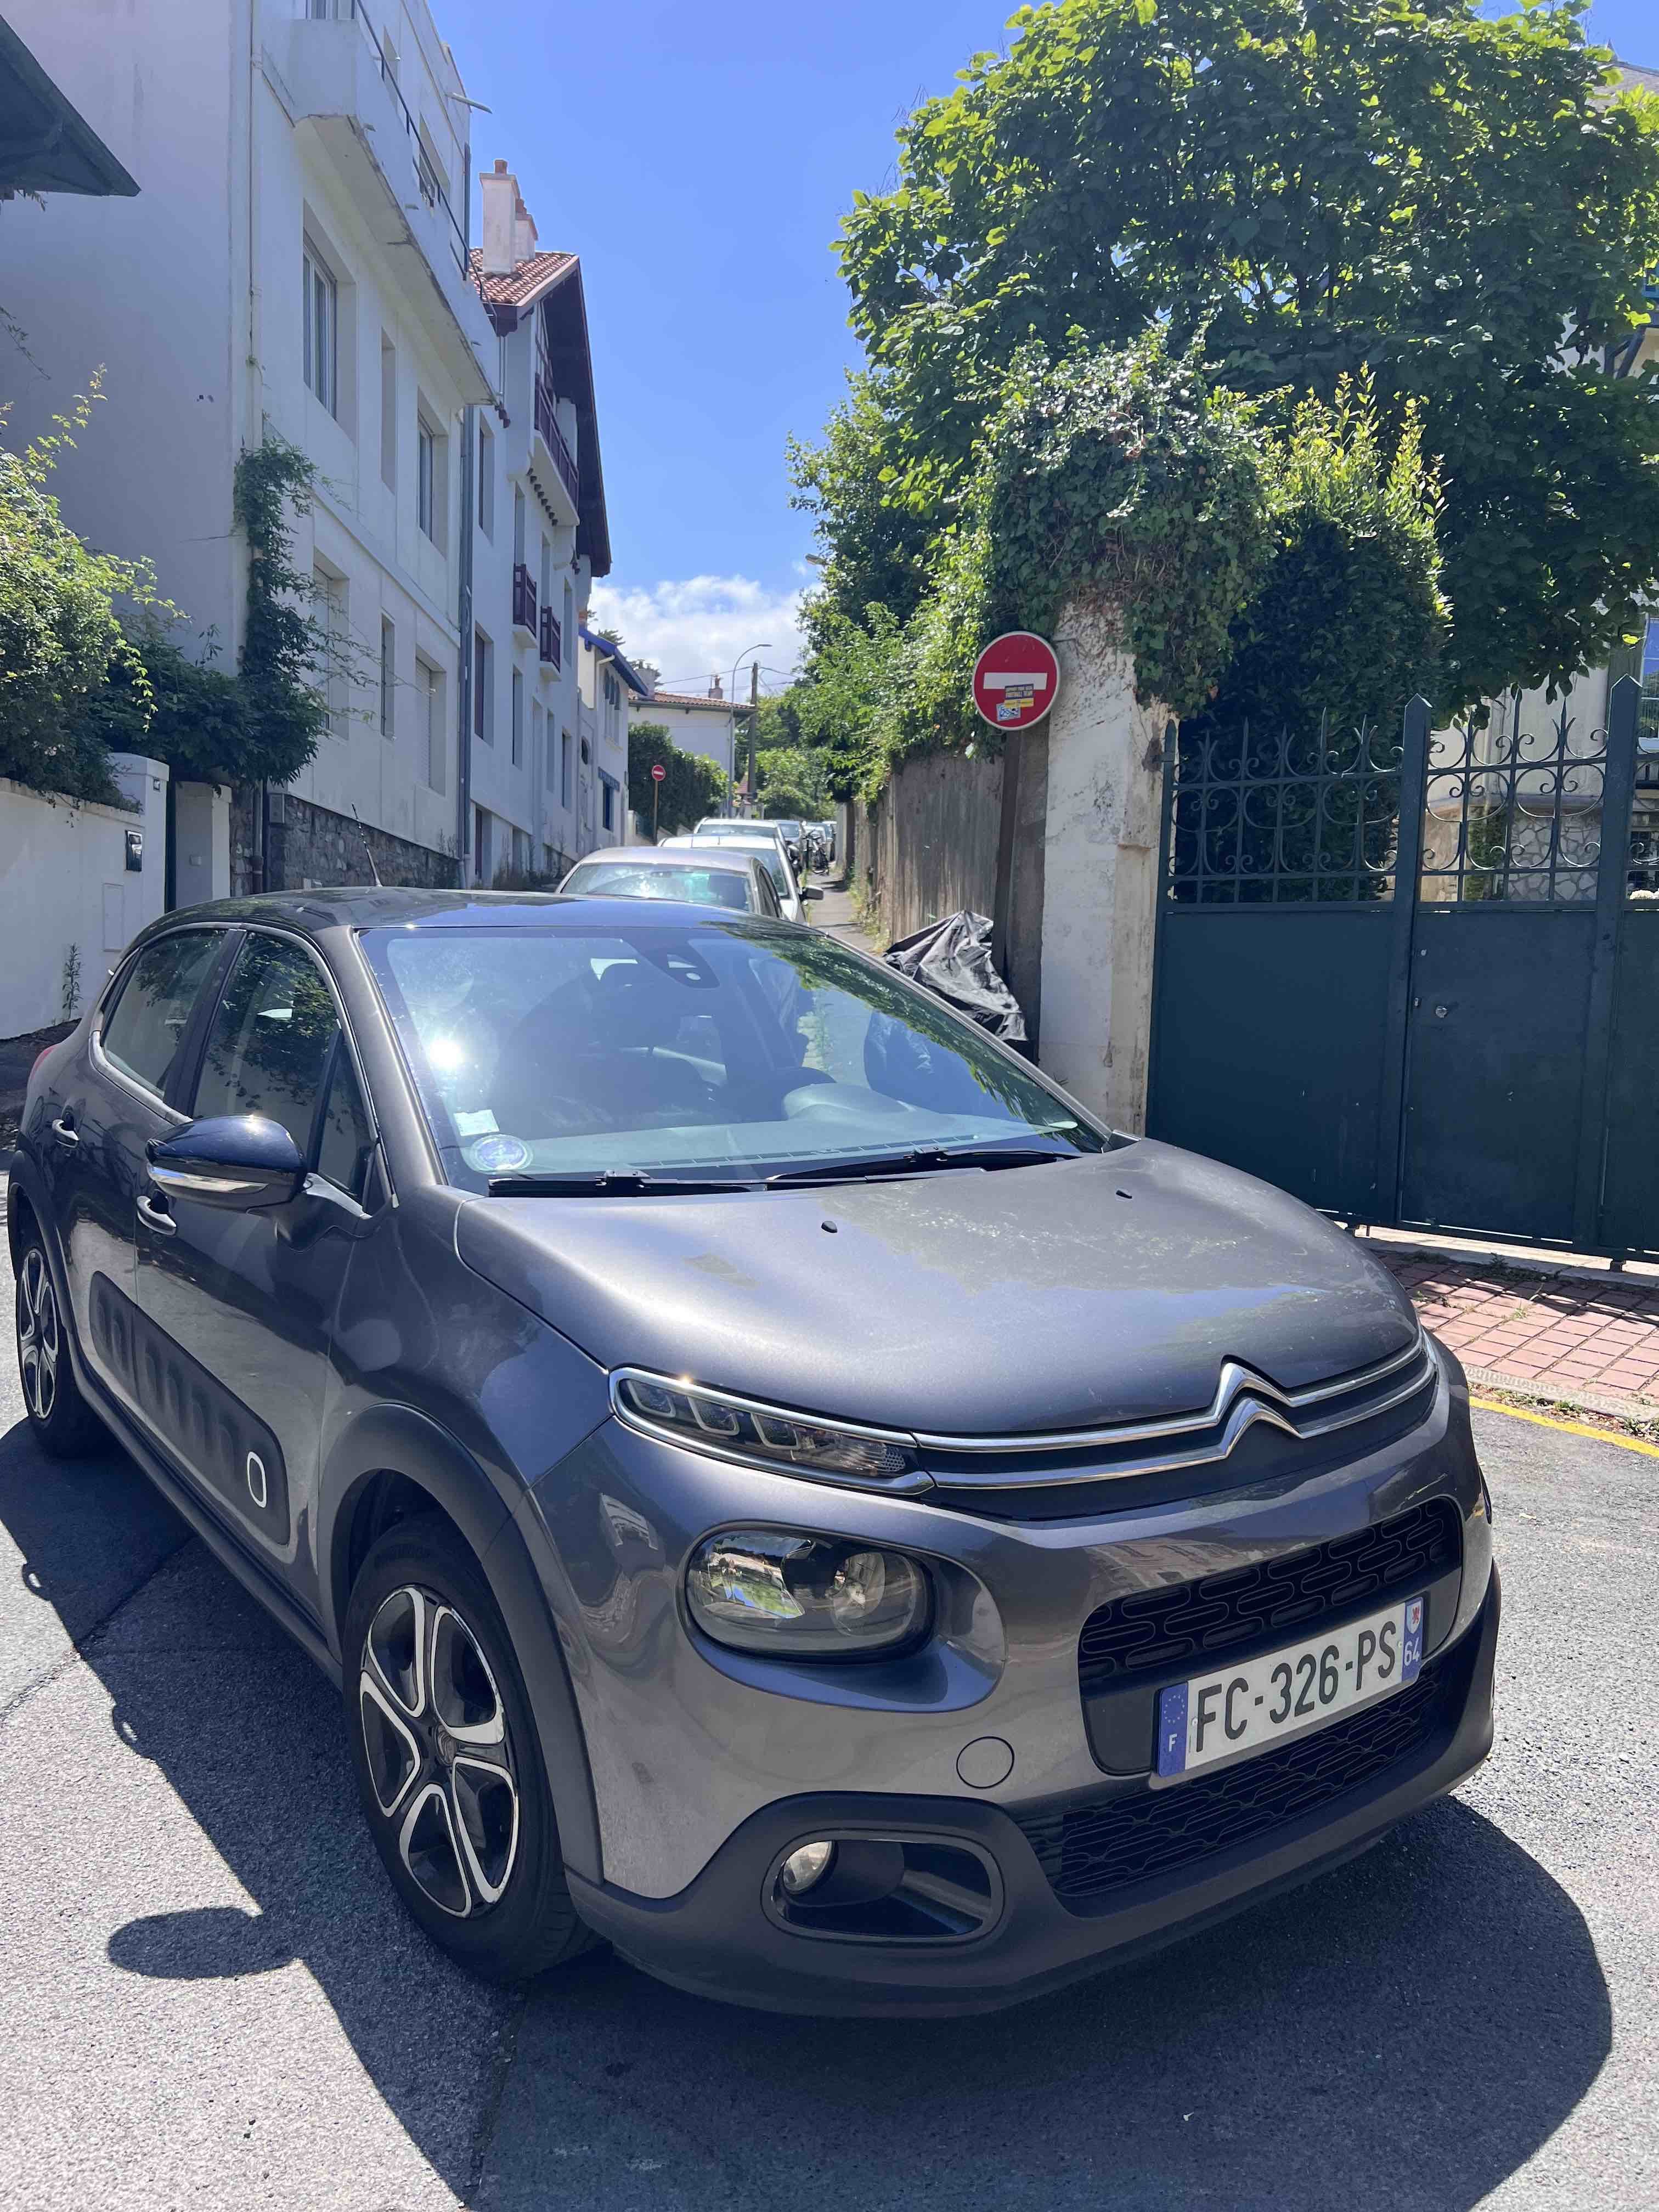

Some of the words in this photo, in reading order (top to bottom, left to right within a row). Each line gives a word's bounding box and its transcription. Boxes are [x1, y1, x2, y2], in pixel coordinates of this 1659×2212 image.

[1404, 1640, 1420, 1666] 64
[1196, 1621, 1396, 1752] FC-326-PS
[1168, 1734, 1178, 1752] F
